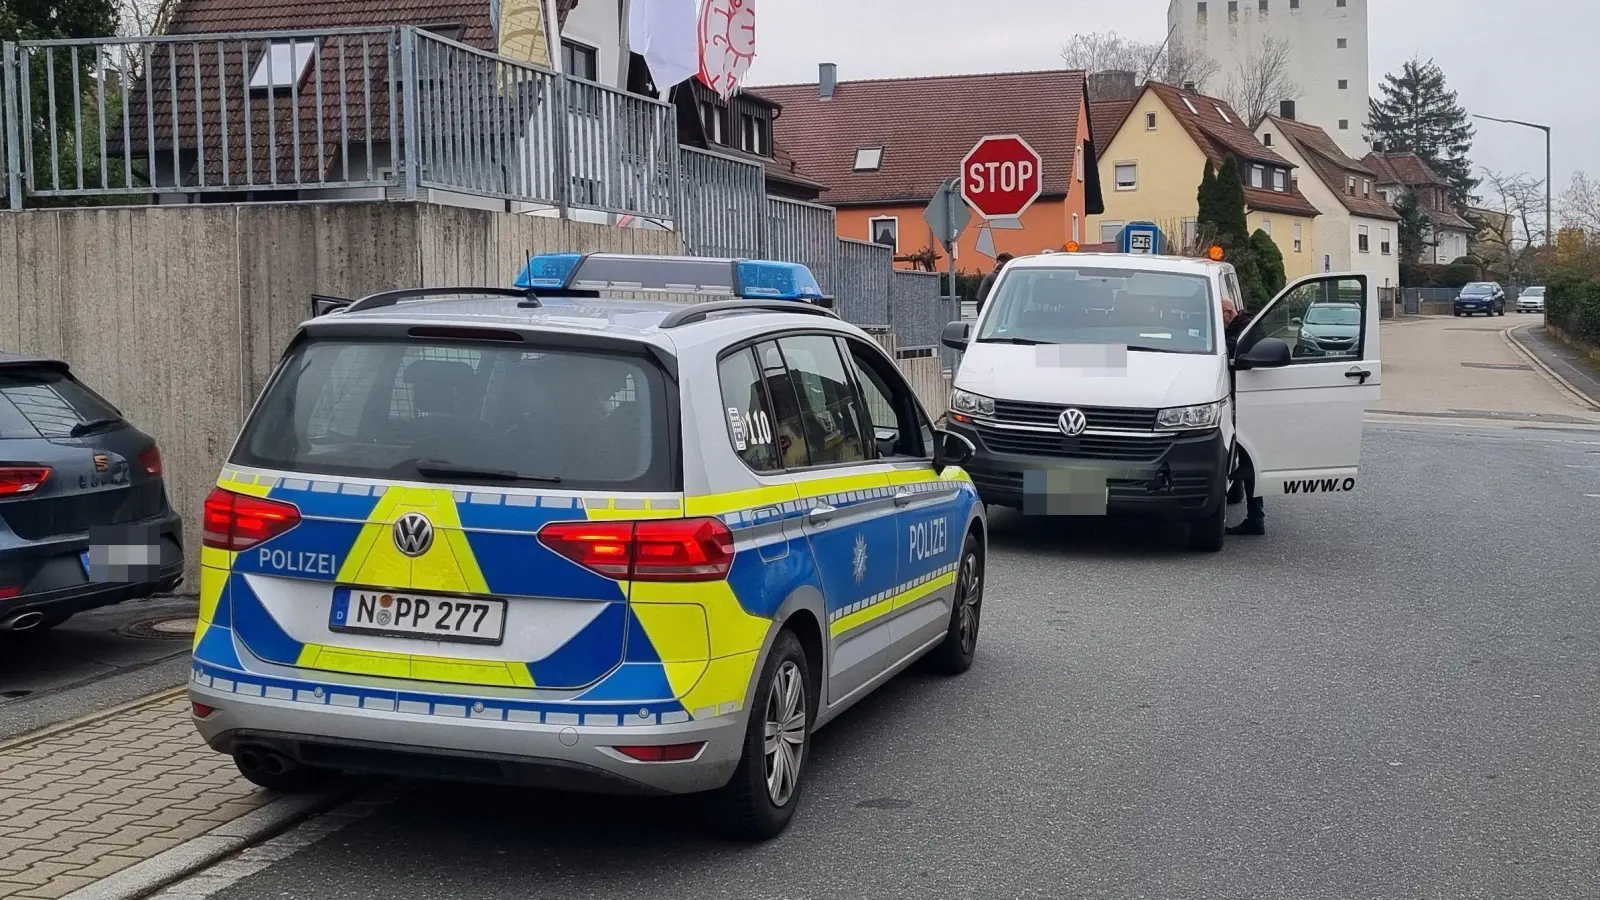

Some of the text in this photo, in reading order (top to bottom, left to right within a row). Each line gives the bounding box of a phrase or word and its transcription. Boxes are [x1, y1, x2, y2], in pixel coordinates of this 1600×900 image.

[969, 160, 1033, 194] STOP
[745, 409, 772, 445] 110
[1283, 477, 1355, 494] www.o
[909, 516, 948, 564] POLIZEI
[259, 547, 336, 575] POLIZEI
[336, 610, 344, 620] D
[356, 594, 490, 633] N PP 277
